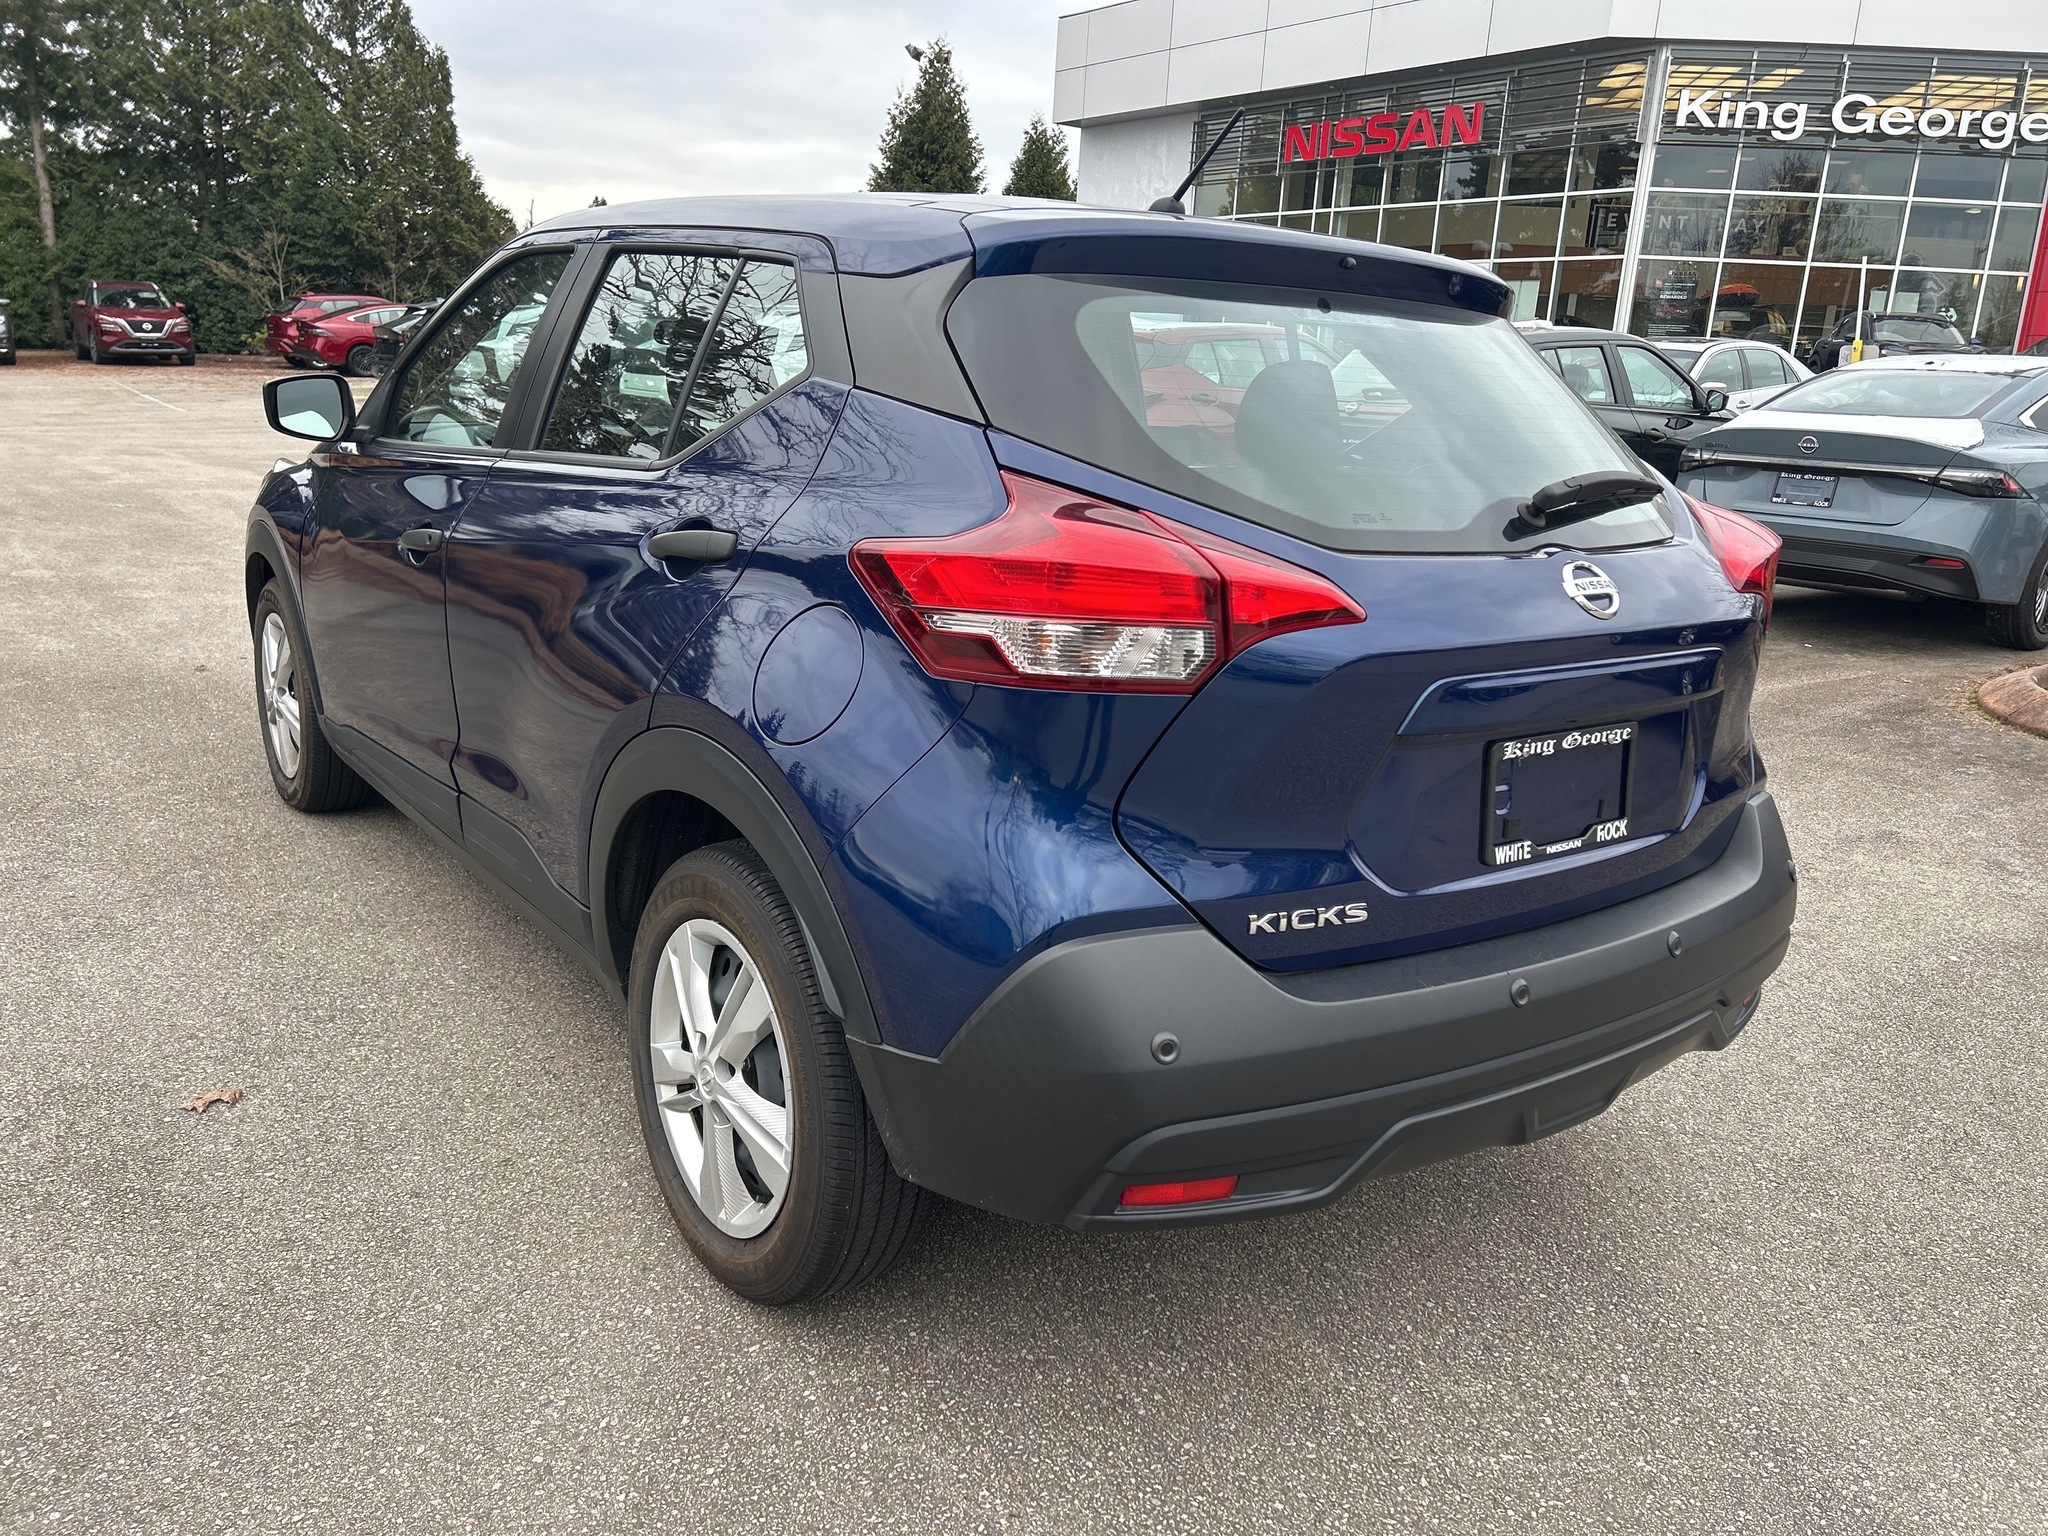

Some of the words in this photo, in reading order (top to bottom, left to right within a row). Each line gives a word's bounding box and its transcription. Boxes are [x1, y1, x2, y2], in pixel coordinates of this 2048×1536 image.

[1284, 101, 1486, 163] NISSAN
[1675, 89, 1808, 141] King
[1831, 94, 2048, 150] George
[1503, 739, 1557, 760] King
[1562, 727, 1632, 749] George
[1495, 841, 1531, 865] WHITE
[1546, 839, 1582, 854] NISSAN
[1597, 819, 1628, 842] ROCK
[1248, 902, 1369, 935] KICKS
